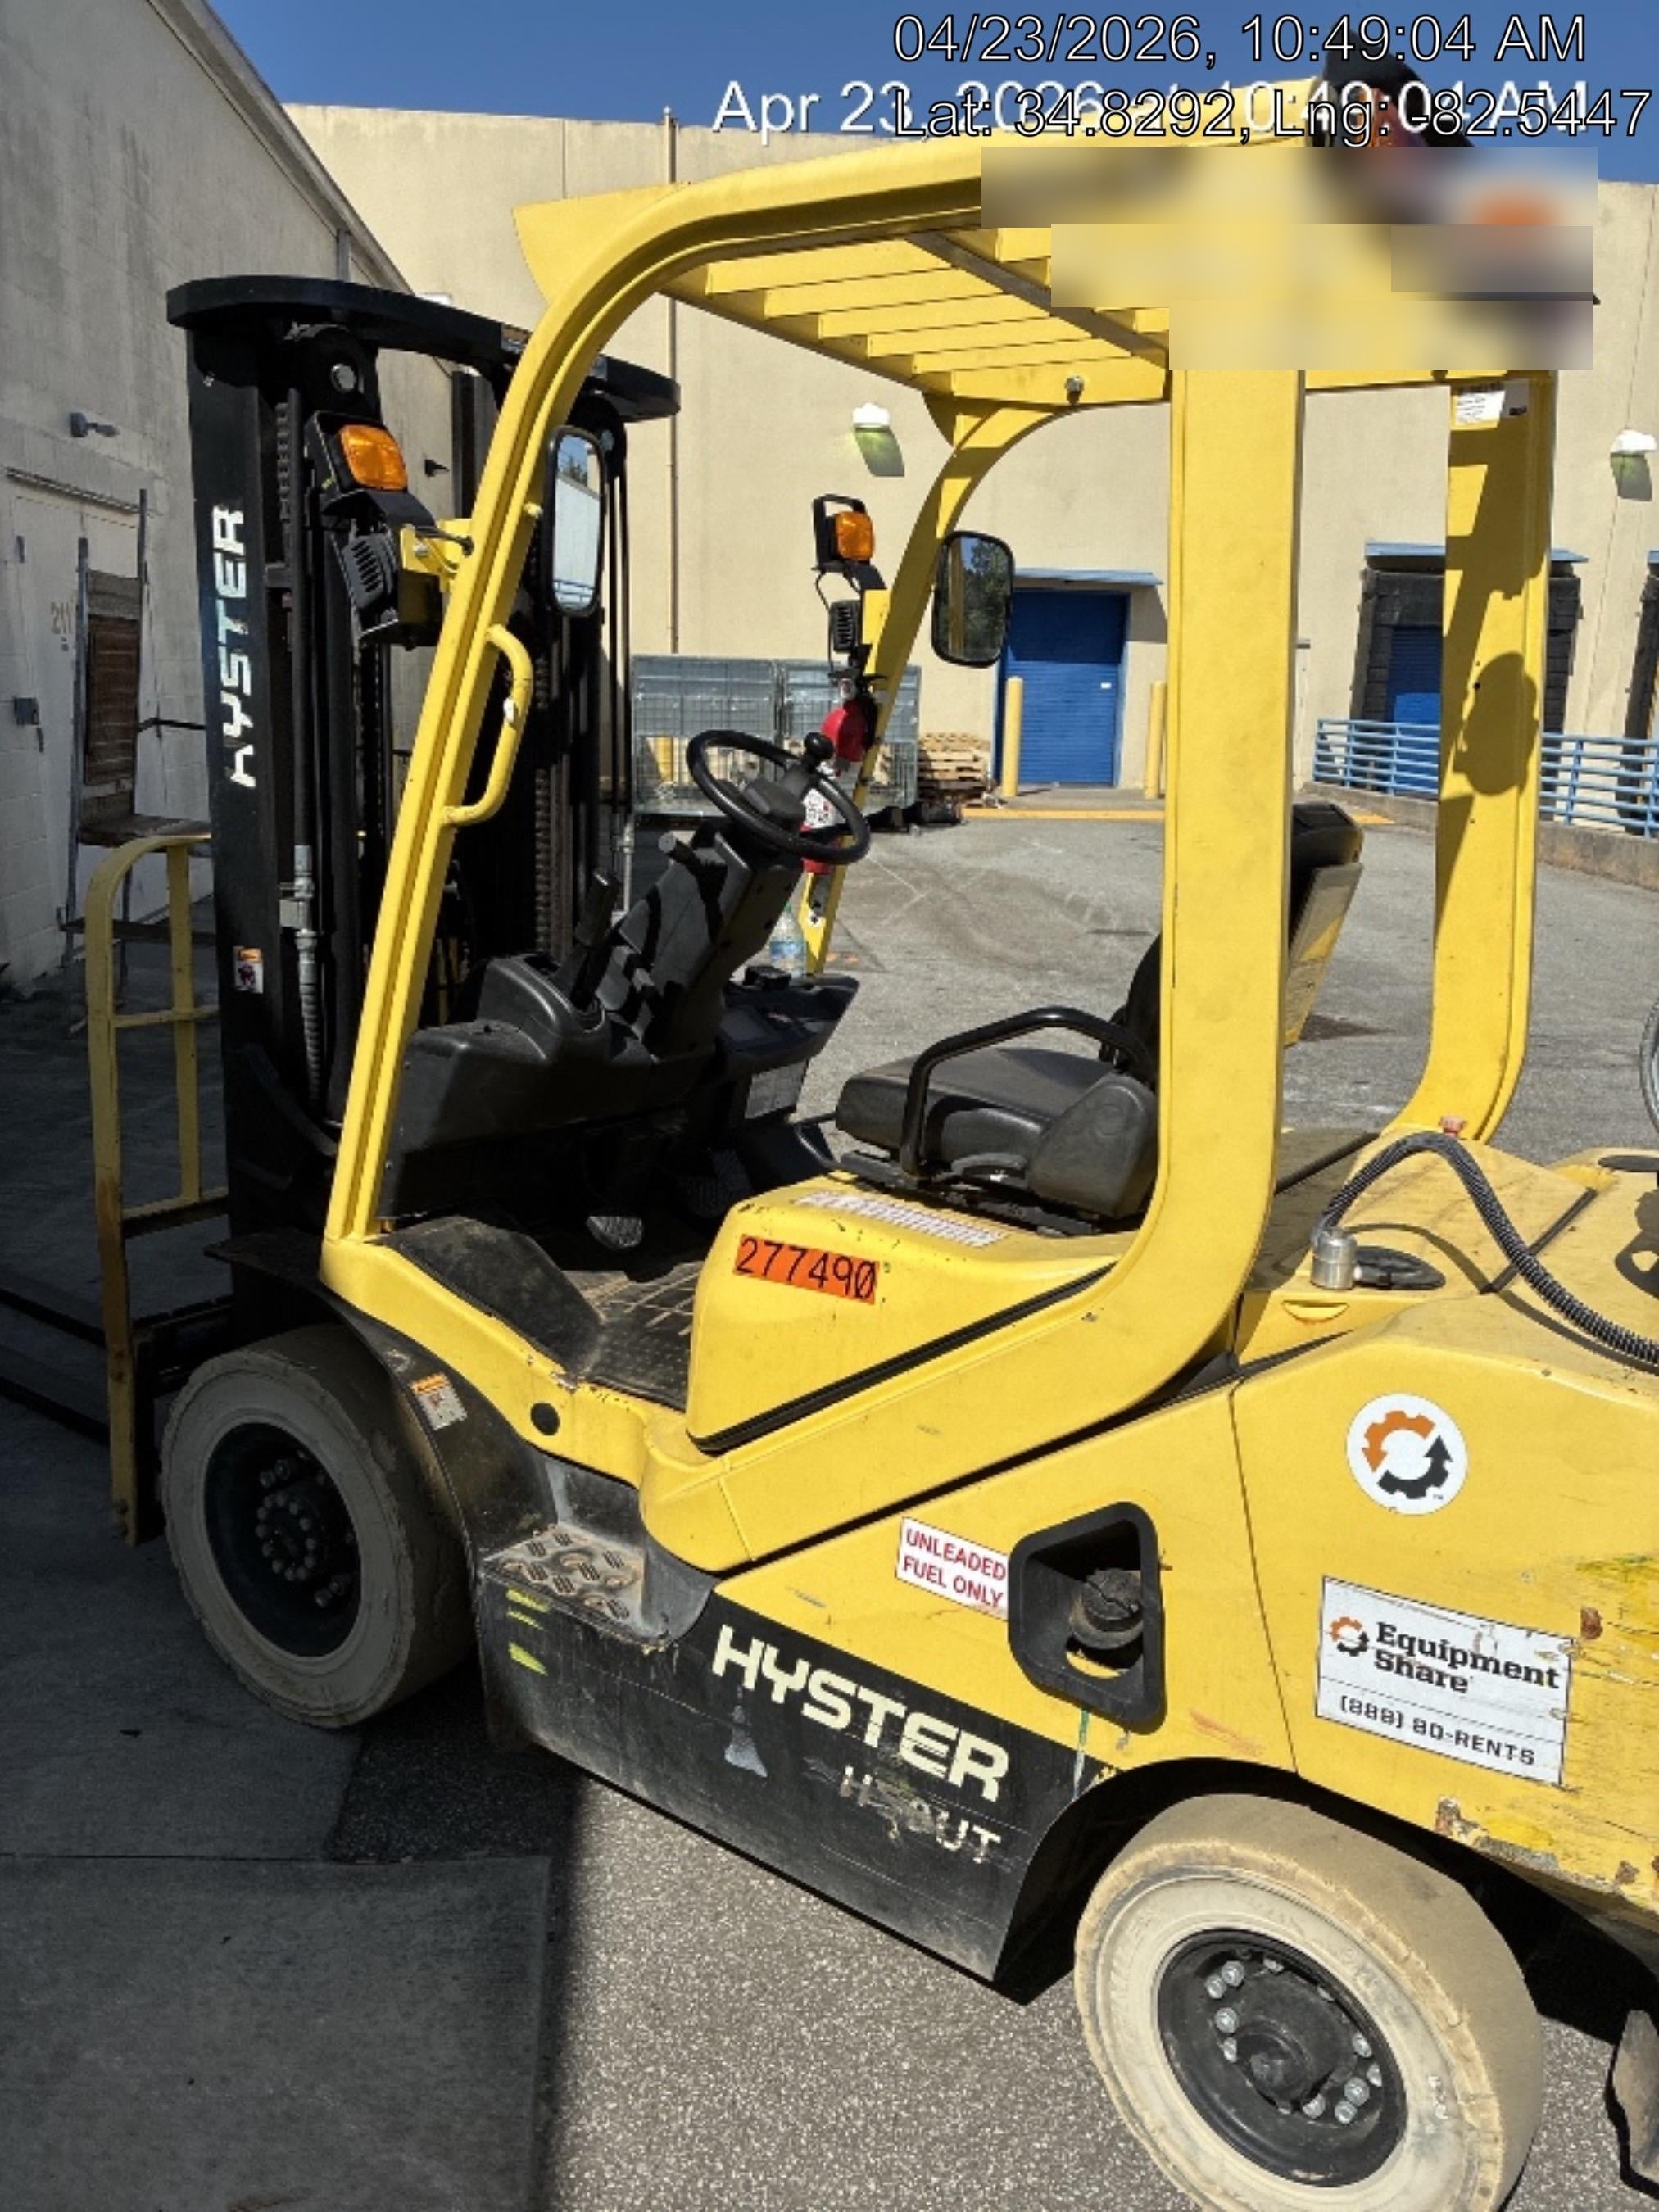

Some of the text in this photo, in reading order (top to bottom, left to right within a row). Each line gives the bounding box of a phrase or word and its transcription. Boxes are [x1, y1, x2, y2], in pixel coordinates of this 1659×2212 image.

[736, 1235, 877, 1299] 277490
[903, 1555, 1004, 1608] FUEL ONLY
[905, 1527, 1007, 1581] UNLEADED
[1373, 1648, 1469, 1694] Share
[1376, 1621, 1561, 1690] Equipment
[711, 1624, 1009, 1802] HYSTER
